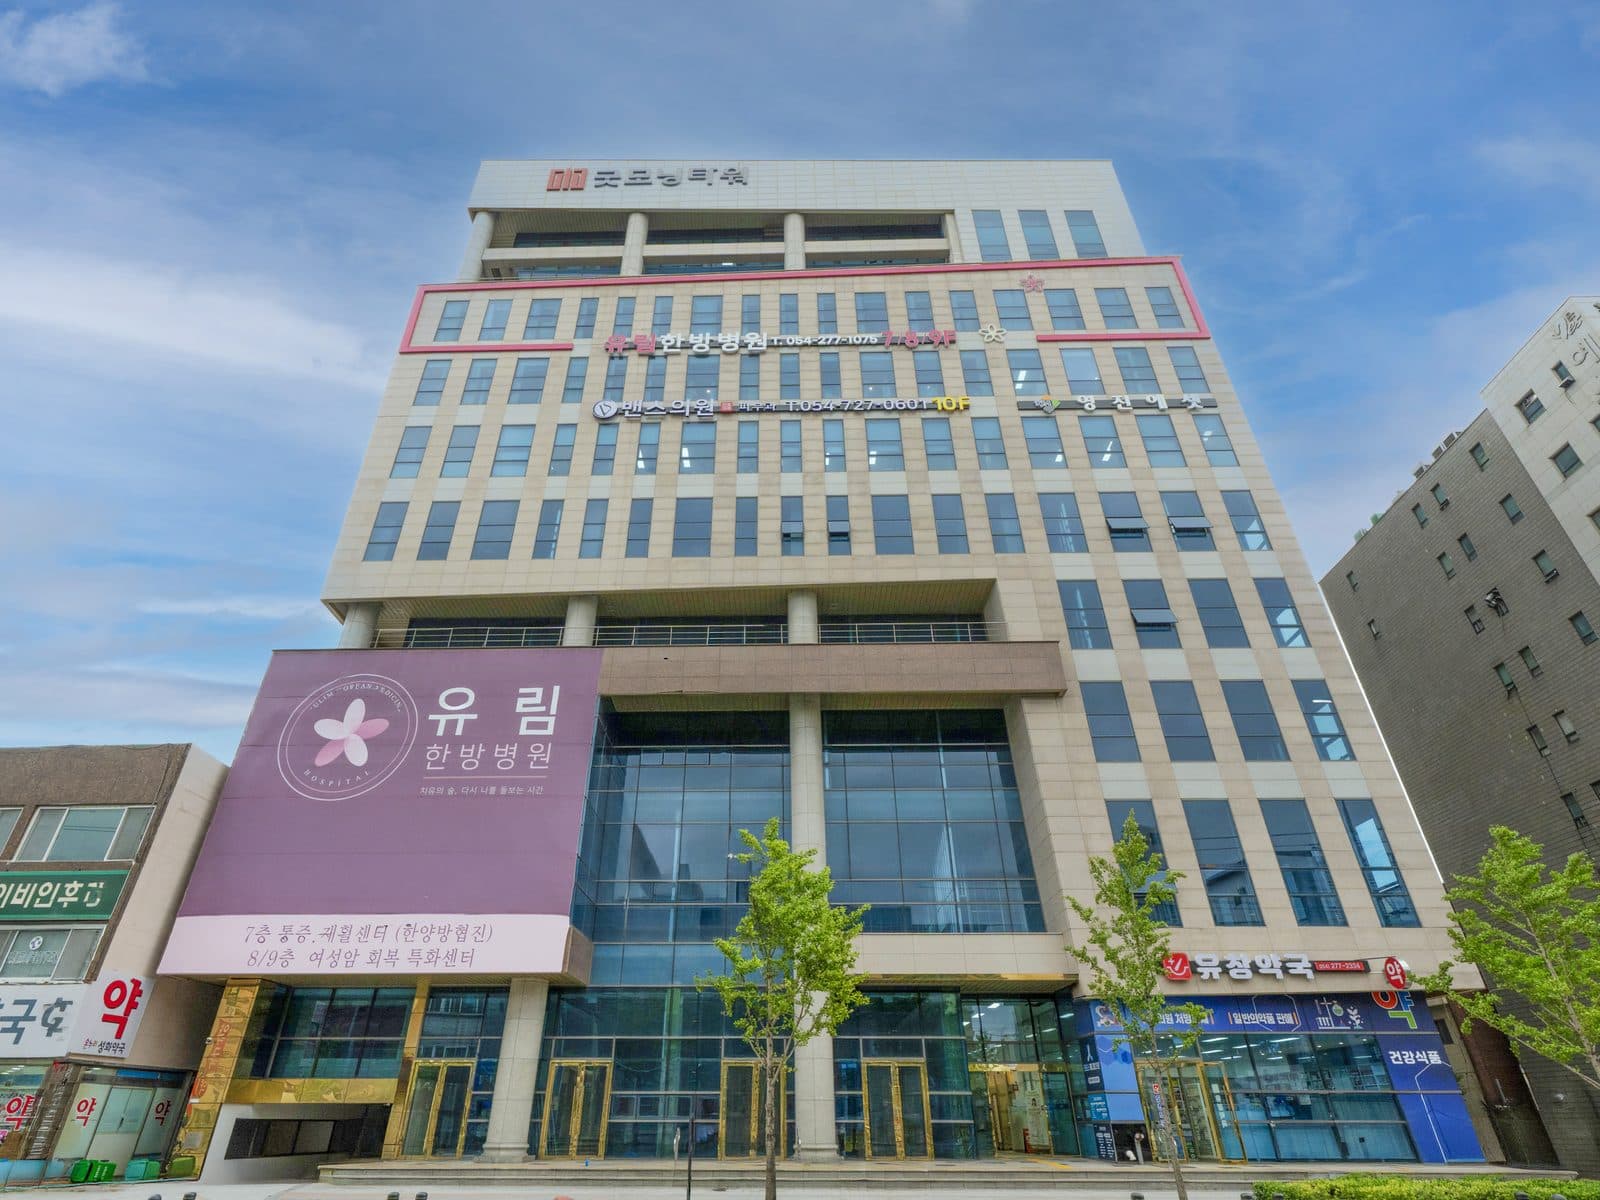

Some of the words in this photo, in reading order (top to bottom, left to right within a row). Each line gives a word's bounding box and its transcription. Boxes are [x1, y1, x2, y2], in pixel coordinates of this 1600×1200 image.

[594, 167, 748, 188] 굿모닝타워
[932, 397, 971, 413] 10F
[428, 685, 560, 736] 유림
[425, 742, 552, 770] 한방병원
[244, 925, 271, 944] 7층
[395, 923, 494, 944] (한양방협진)
[247, 948, 296, 968] 8/9층
[309, 948, 360, 968] 여성암
[366, 948, 400, 967] 회복
[407, 947, 475, 968] 특화센터
[1387, 961, 1404, 984] 약
[102, 978, 143, 1040] 약
[1233, 1012, 1275, 1025] 일반의약품
[1371, 991, 1417, 1030] 약
[1388, 1050, 1442, 1065] 건강식품
[75, 1097, 97, 1127] 약
[155, 1098, 171, 1126] 약
